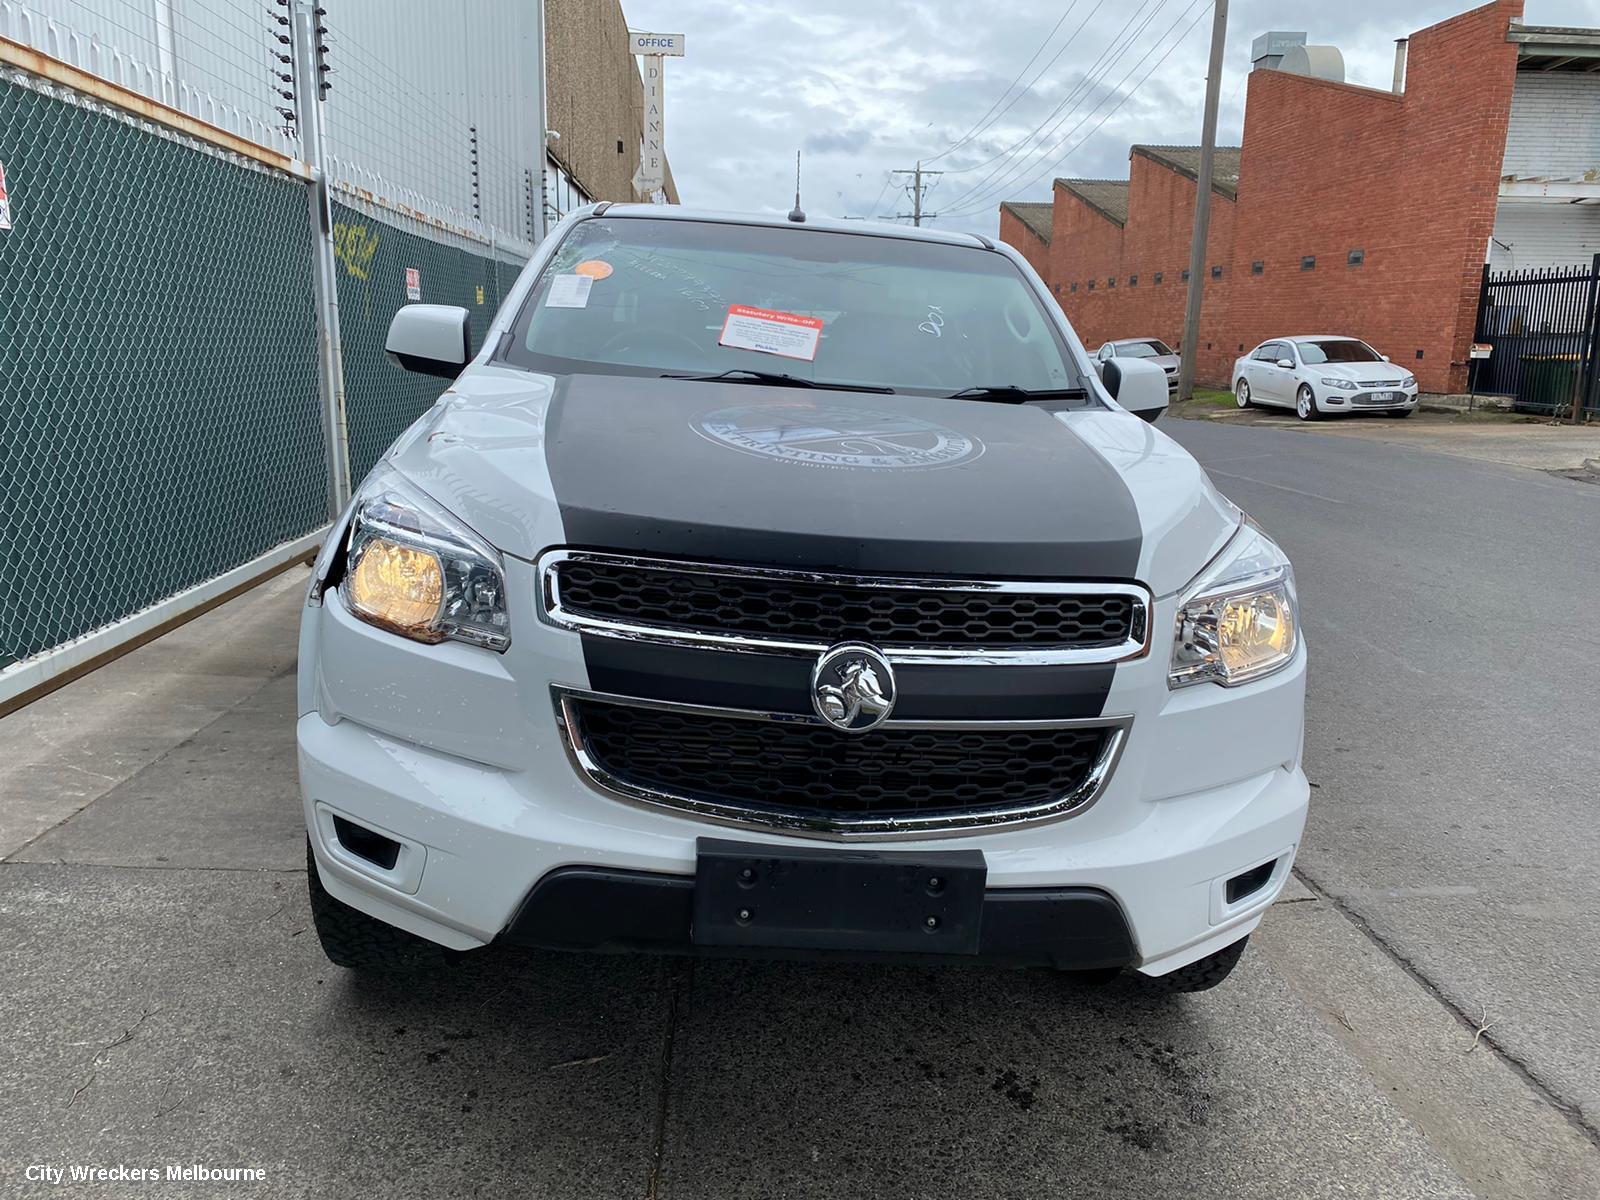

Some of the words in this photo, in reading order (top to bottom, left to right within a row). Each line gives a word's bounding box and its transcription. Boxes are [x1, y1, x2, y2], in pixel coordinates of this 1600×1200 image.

[637, 38, 674, 48] OFFICE
[649, 67, 659, 169] DIANNE
[736, 308, 775, 319] Statutory
[777, 314, 816, 326] Write-Off
[730, 432, 860, 463] PRINTING
